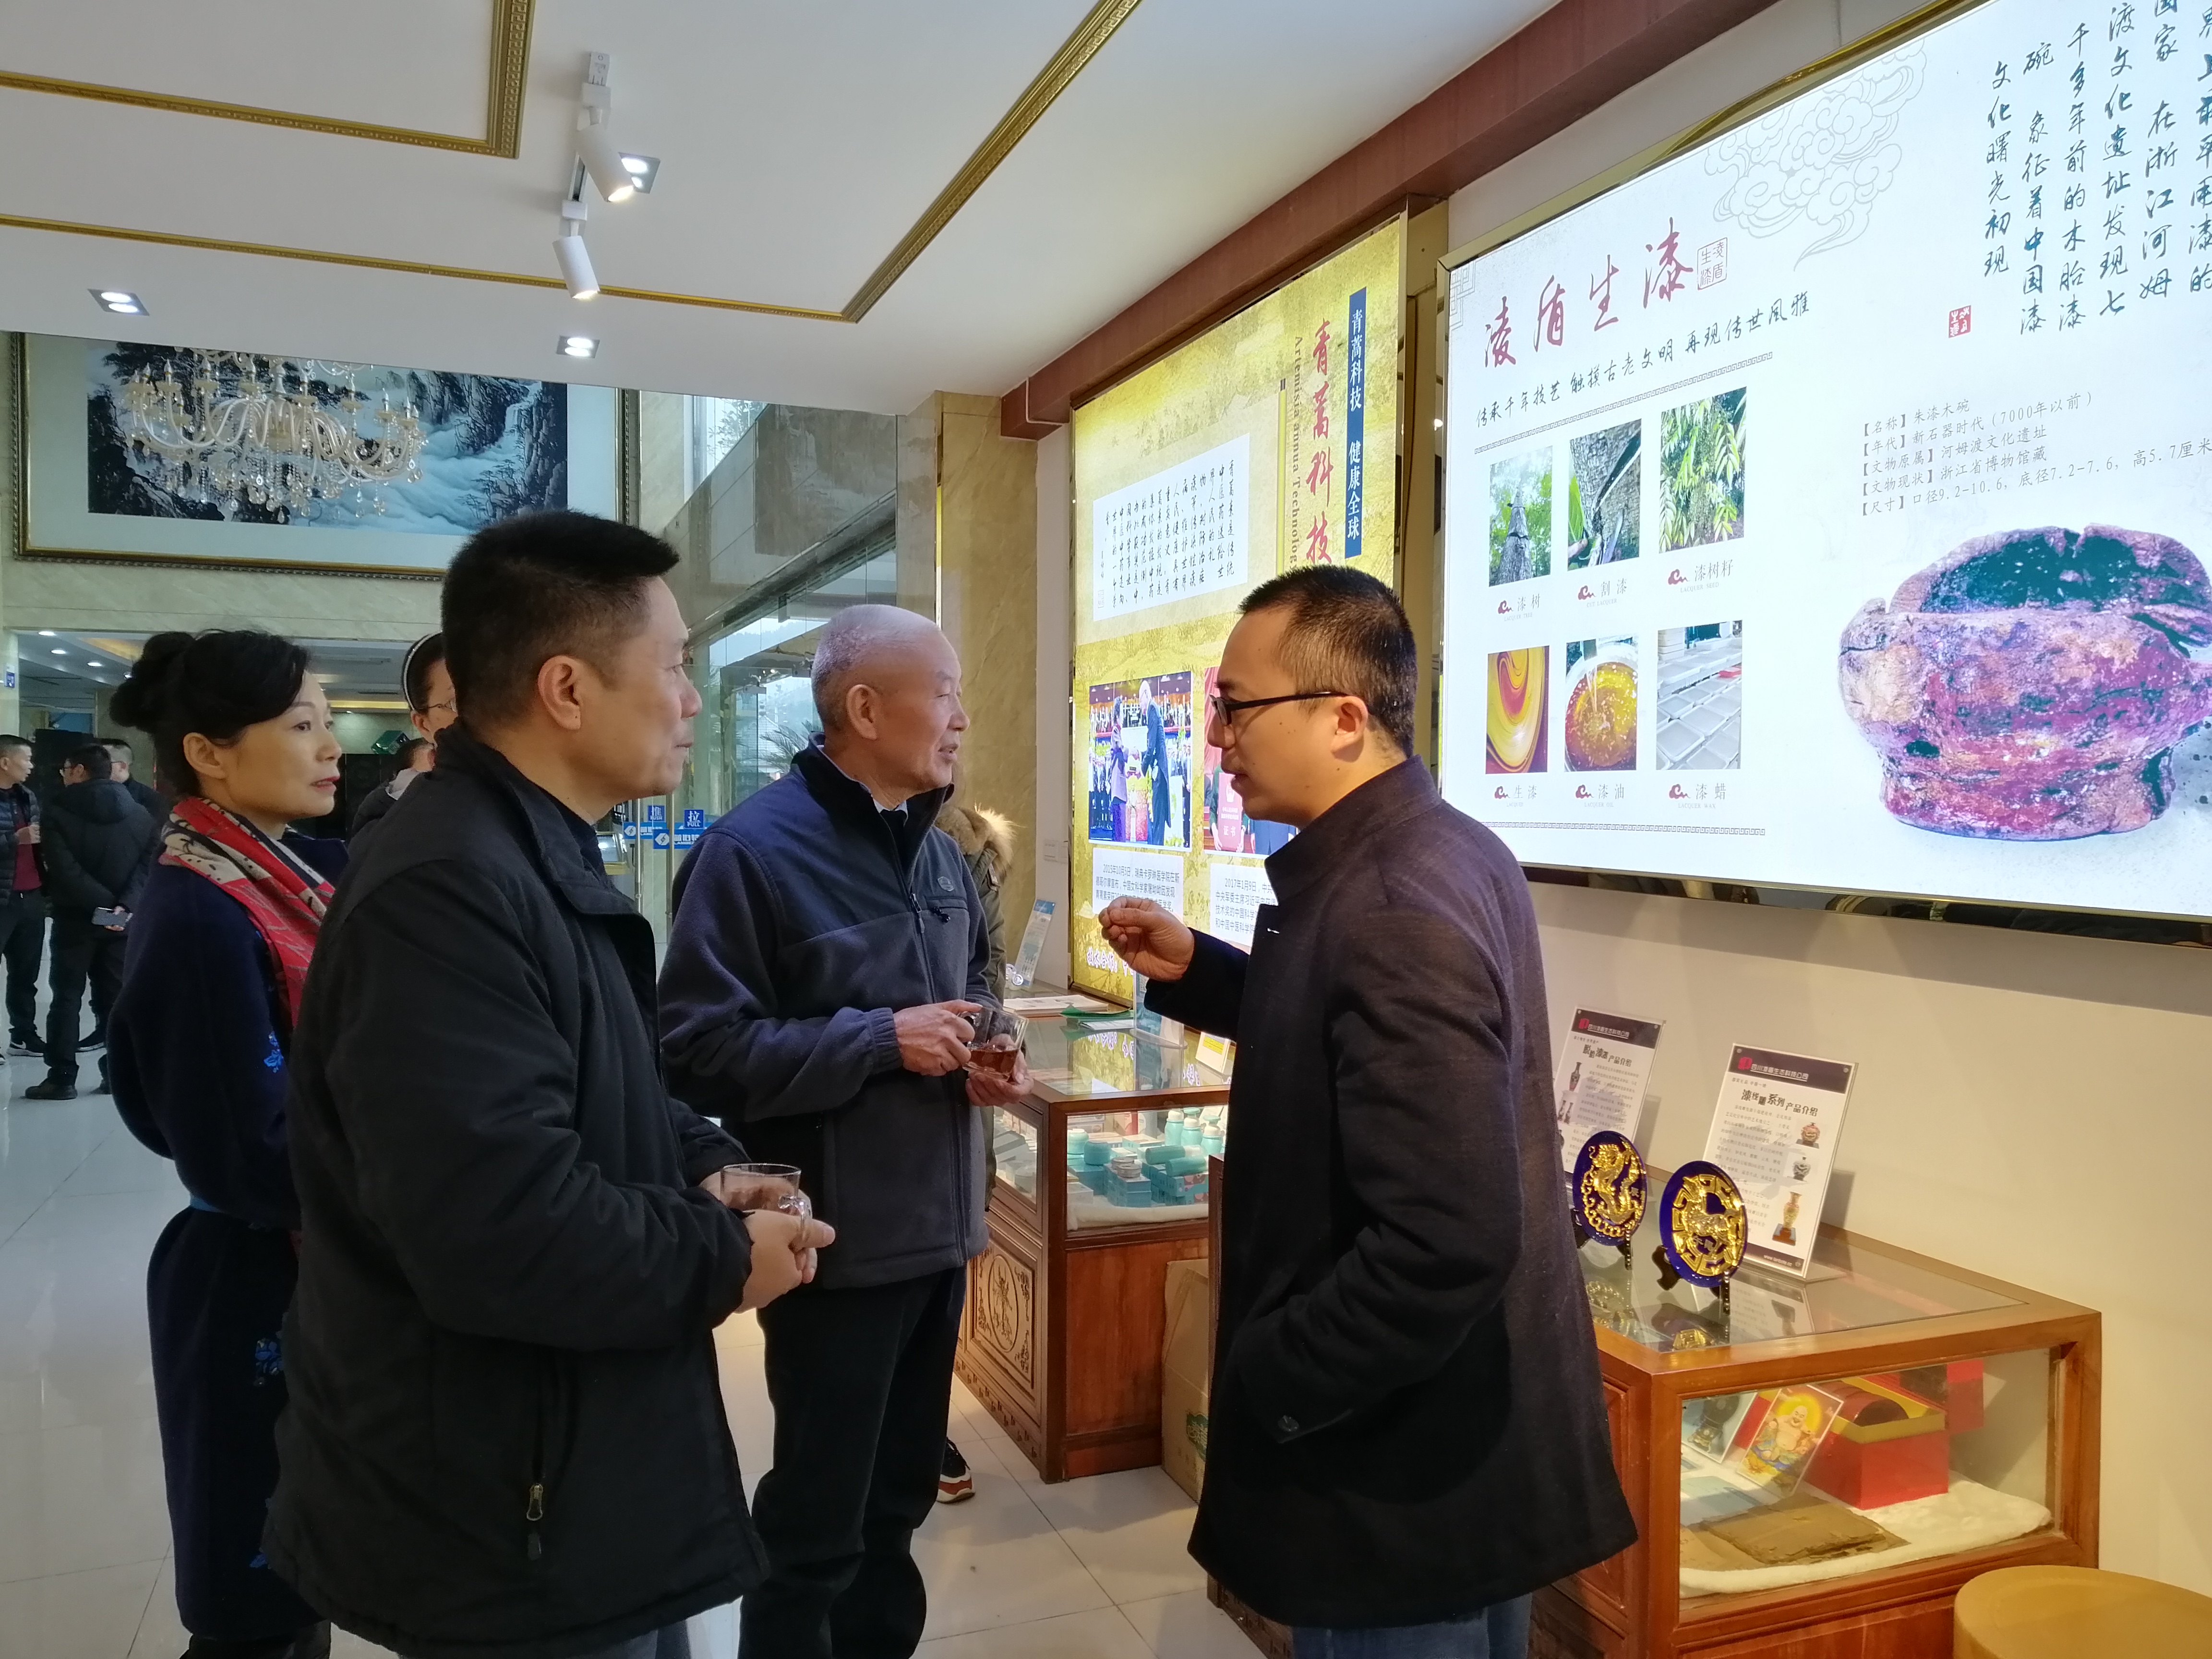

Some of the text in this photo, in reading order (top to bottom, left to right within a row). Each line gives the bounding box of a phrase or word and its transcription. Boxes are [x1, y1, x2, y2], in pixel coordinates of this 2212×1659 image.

[1984, 61, 2012, 277] 文化曙光初现
[2059, 23, 2090, 331] 千多年前的木胎漆
[2099, 3, 2135, 315] 渡文化遗址发现七
[1293, 336, 1303, 418] Artemisia
[1347, 309, 1363, 540] 青蒿科技 健康全球
[1476, 380, 1561, 428] 传承千年技艺
[1514, 785, 1537, 799] 生漆
[1598, 783, 1625, 800] 漆油
[1695, 783, 1727, 800] 漆蜡
[688, 810, 700, 822] 拉
[1224, 825, 1236, 837] 证书
